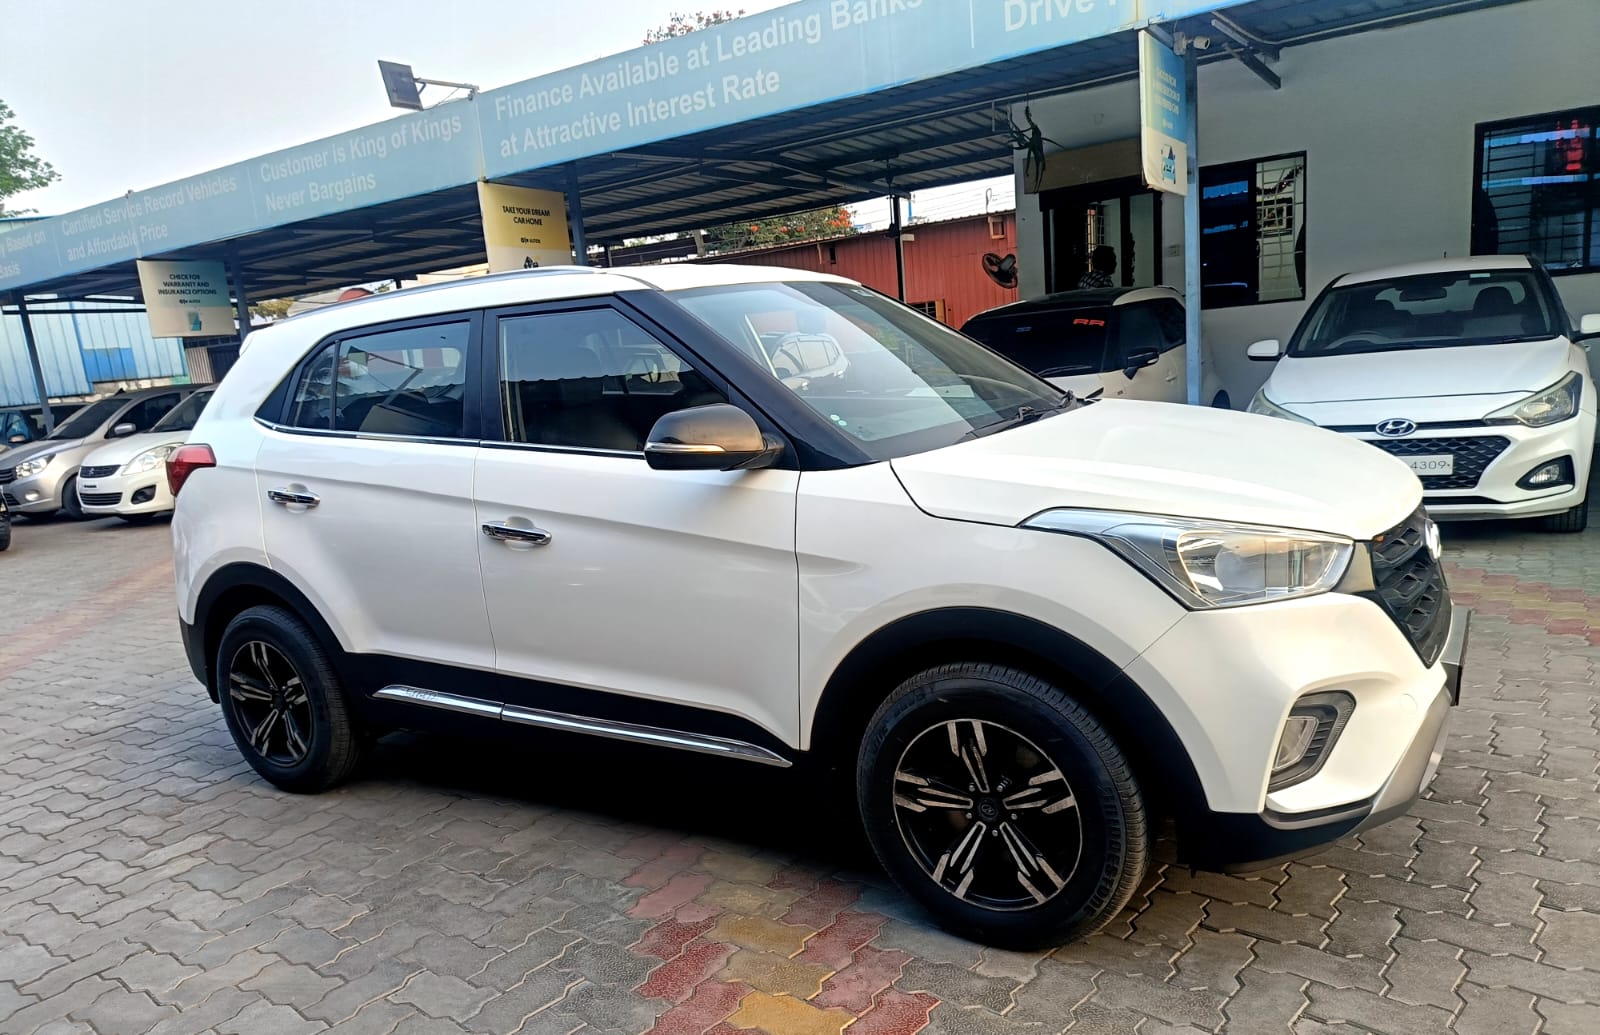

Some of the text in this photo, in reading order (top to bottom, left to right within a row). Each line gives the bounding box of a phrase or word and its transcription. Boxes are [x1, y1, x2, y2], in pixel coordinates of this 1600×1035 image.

[495, 84, 573, 120] Finance
[579, 52, 680, 99] Available
[688, 42, 710, 71] at
[717, 13, 821, 62] Leading
[500, 69, 780, 158] at Attractive Interest Rate
[261, 150, 328, 182] Customer
[350, 135, 387, 159] King
[391, 123, 409, 149] of
[412, 115, 462, 143] Kings
[62, 175, 238, 236] Certified Service Record Vehicles
[265, 171, 376, 212] Never Bargains
[502, 205, 551, 216] TAKE YOUR DREAM
[67, 222, 168, 261] and Affordable Price
[526, 217, 543, 226] HOME
[1409, 460, 1447, 470] 4309
